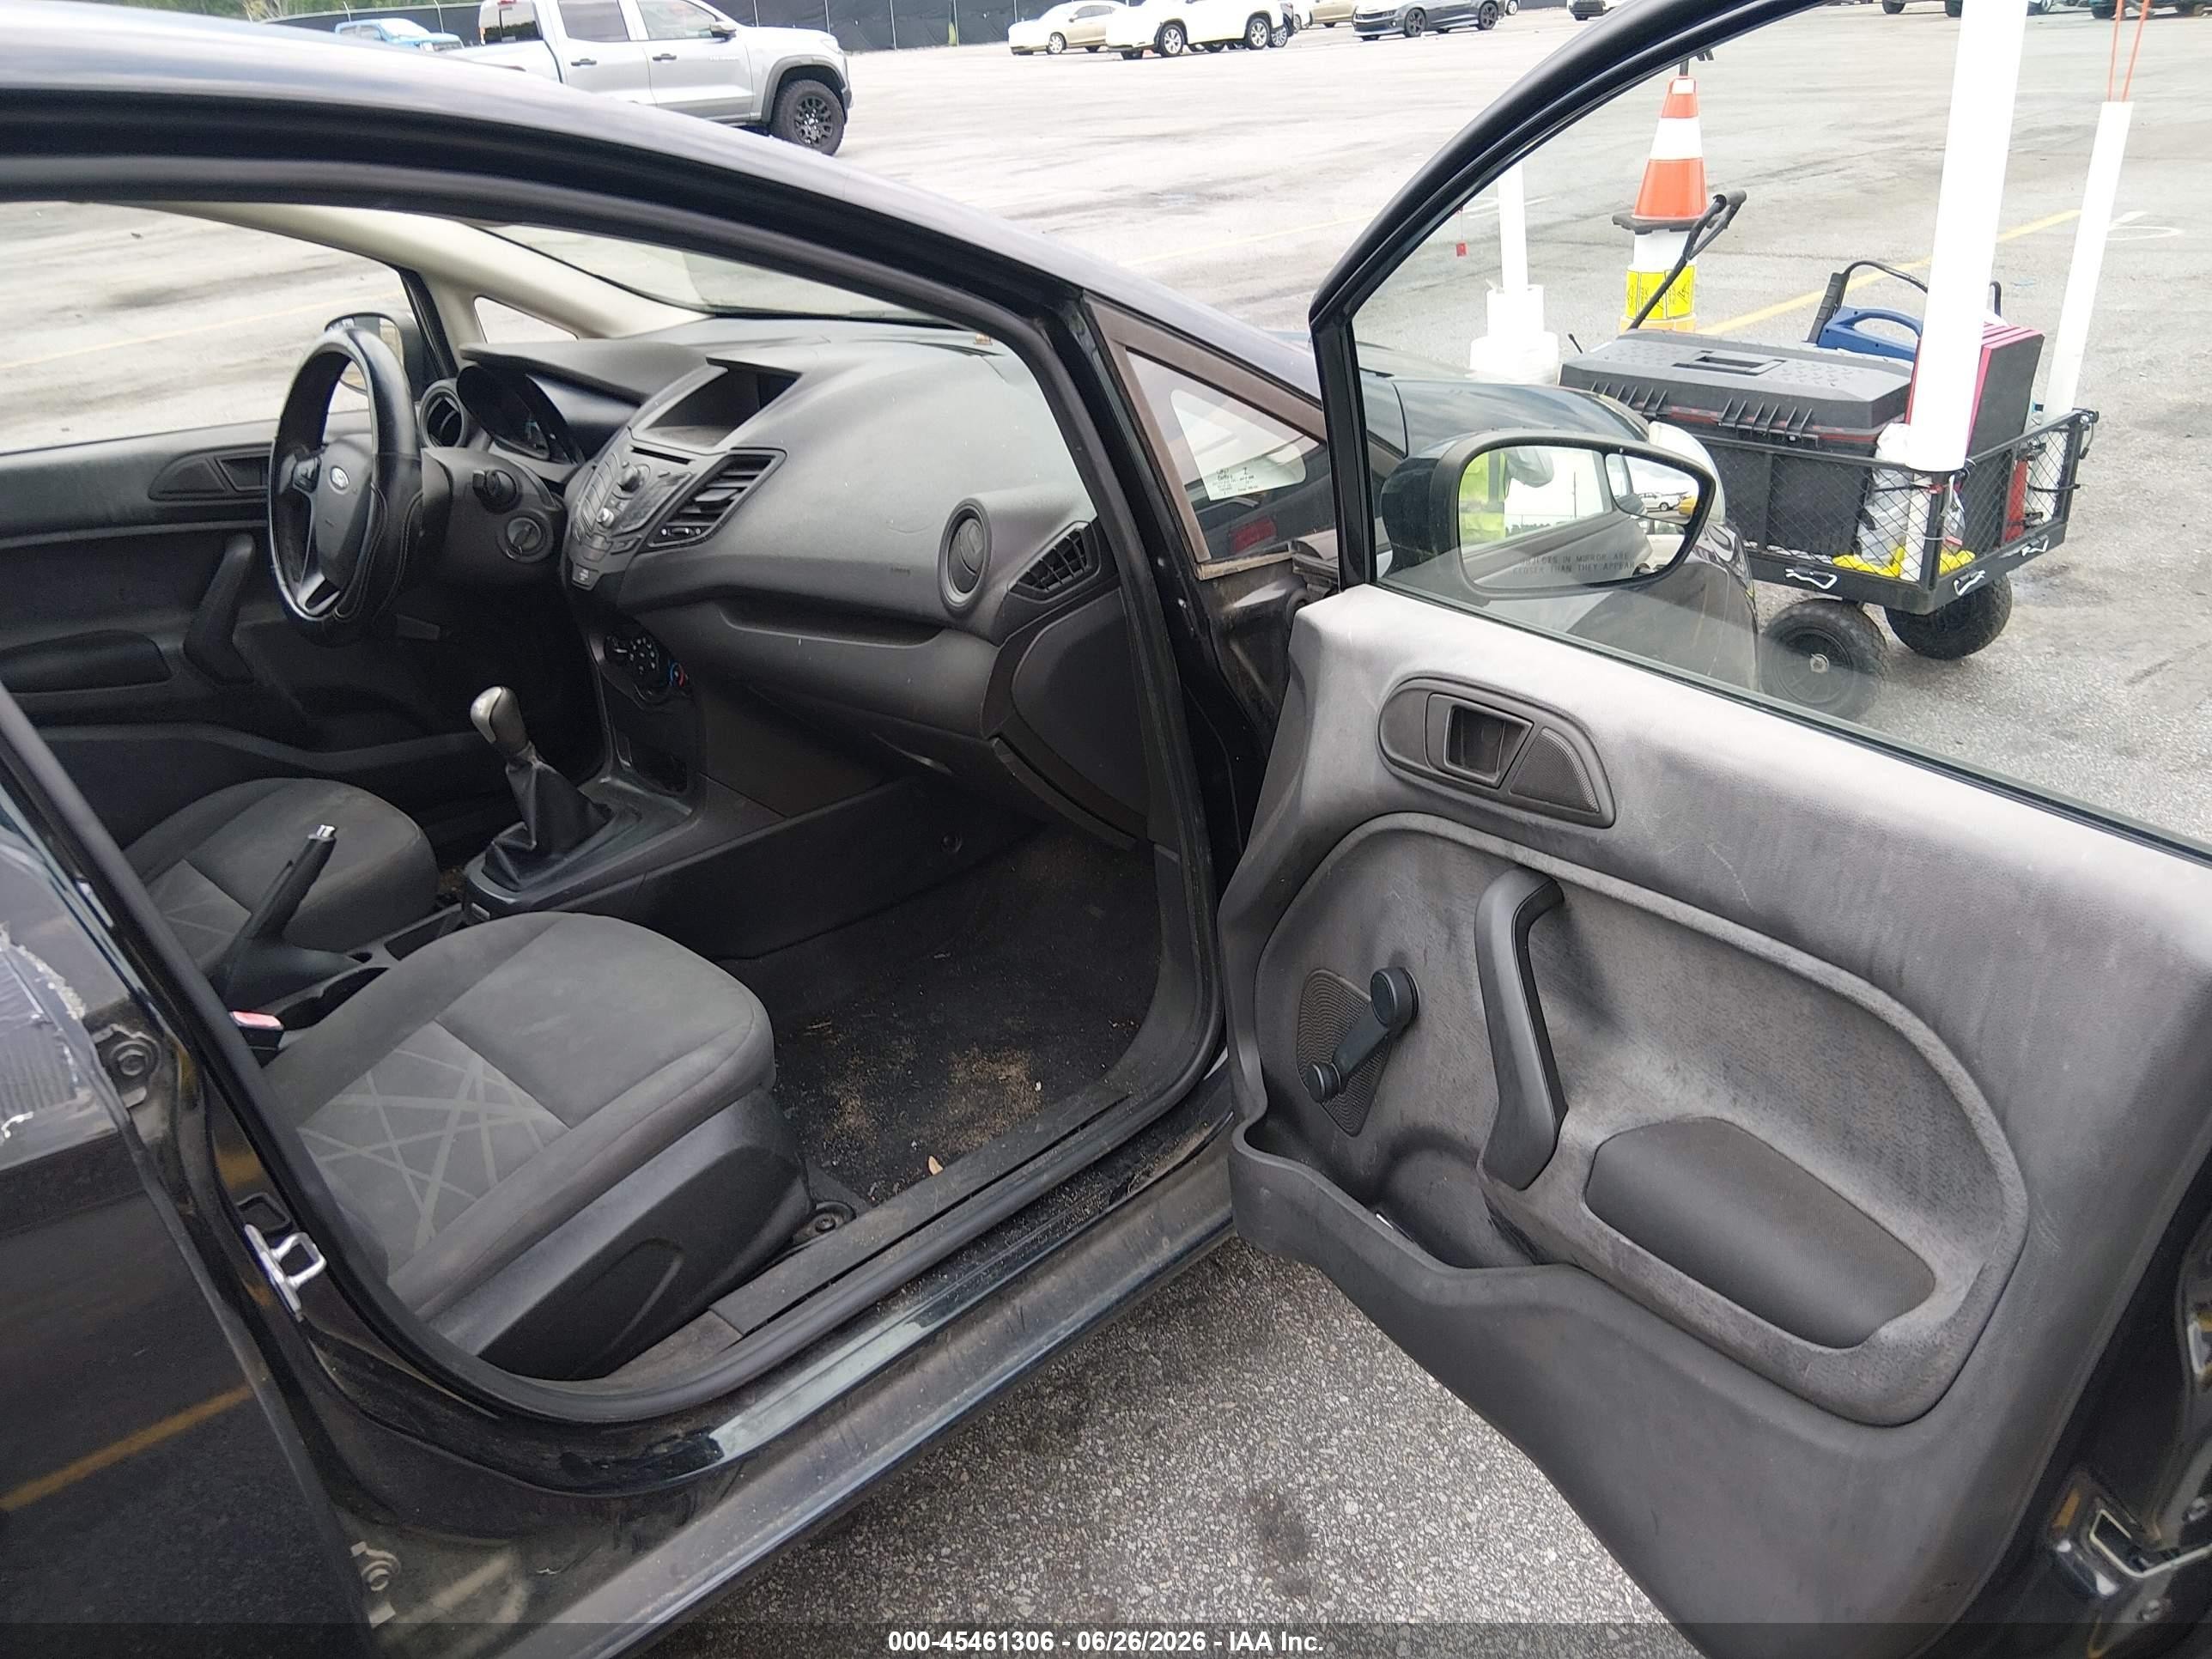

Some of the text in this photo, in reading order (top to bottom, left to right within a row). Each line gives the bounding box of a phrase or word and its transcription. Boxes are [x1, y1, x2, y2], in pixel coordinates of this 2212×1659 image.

[1577, 553, 1607, 562] MIRROR
[1614, 551, 1628, 560] ARE
[1551, 564, 1572, 573] THAN
[1578, 562, 1597, 571] THEY
[1602, 561, 1634, 570] APPEAR
